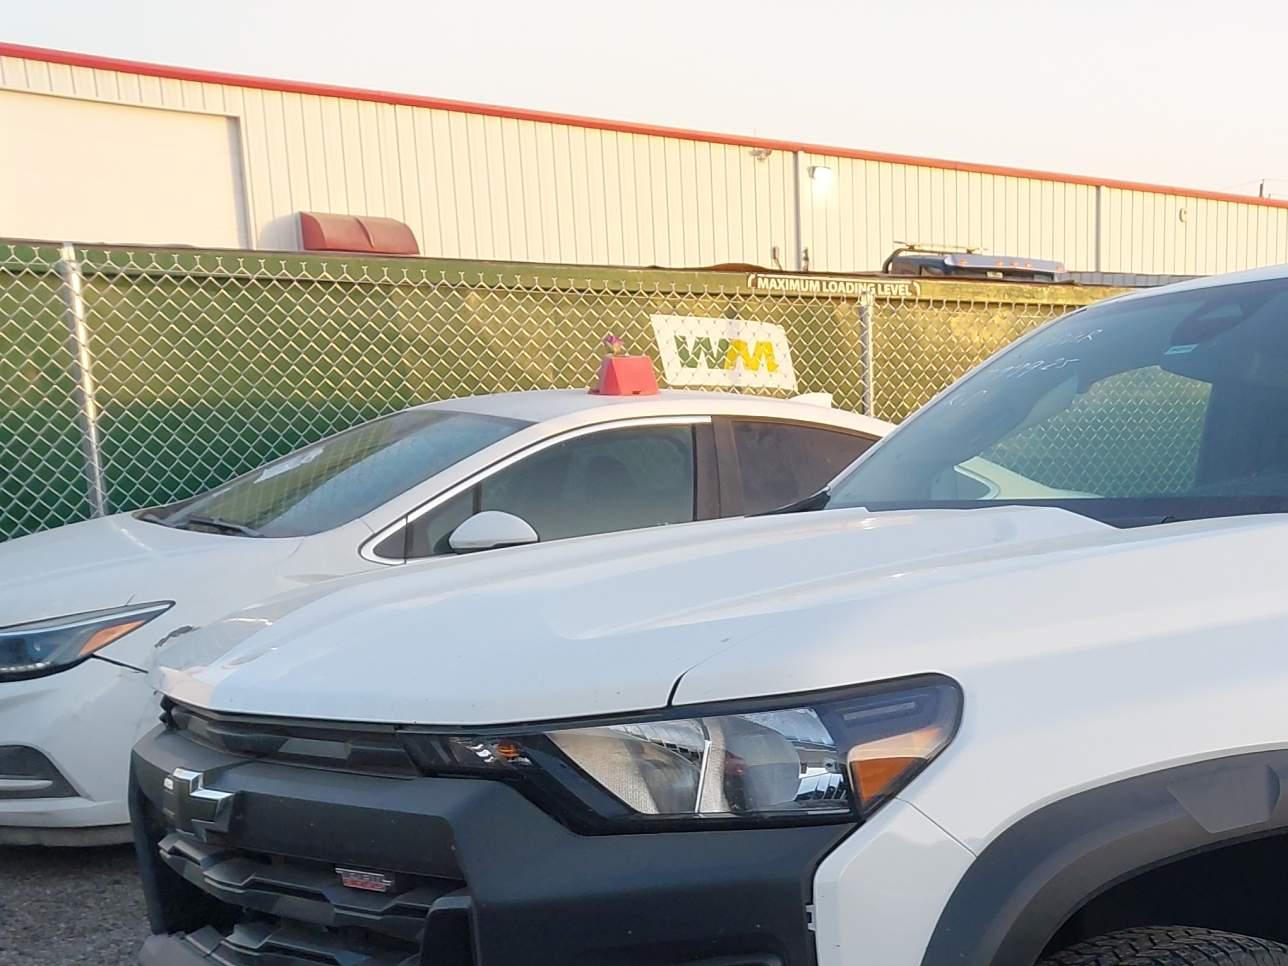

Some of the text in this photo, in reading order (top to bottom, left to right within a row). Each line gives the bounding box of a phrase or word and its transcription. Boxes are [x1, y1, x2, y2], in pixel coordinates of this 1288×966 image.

[757, 277, 912, 297] MAXIMUM LOADING LEVEL
[674, 335, 779, 373] WM
